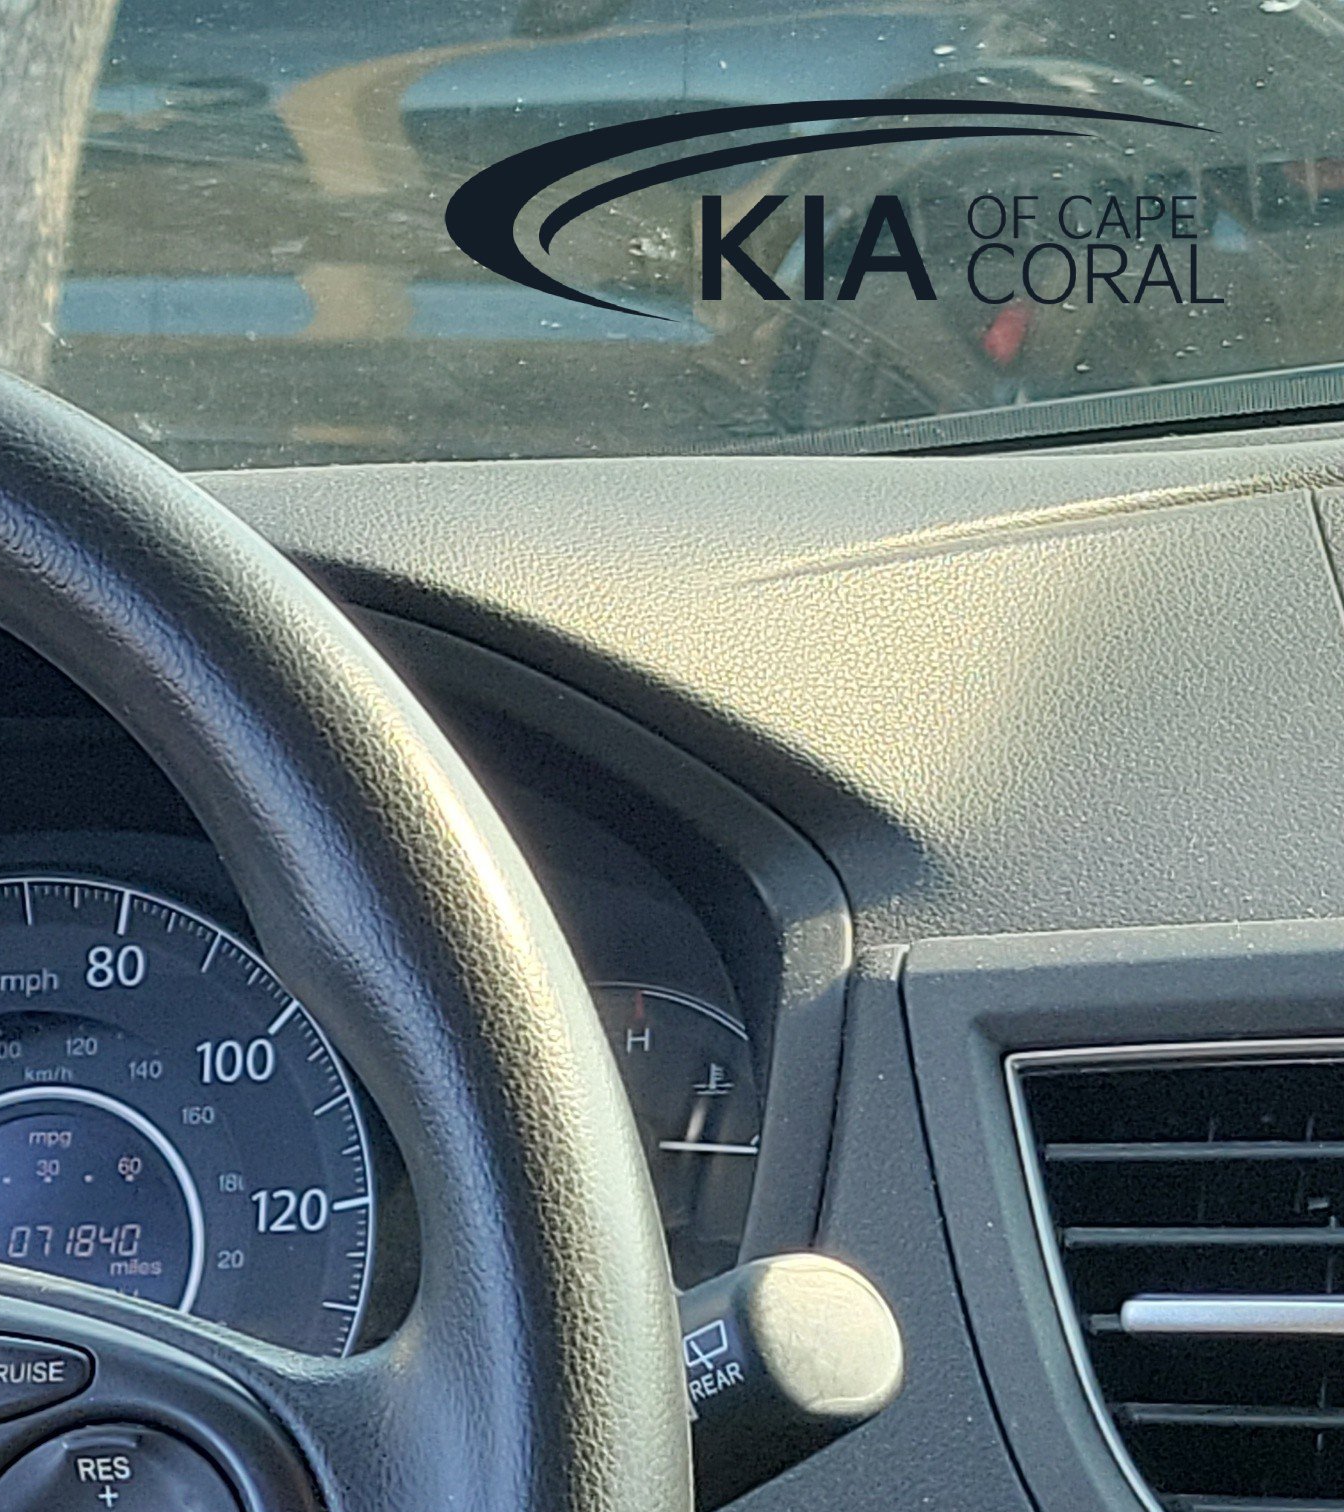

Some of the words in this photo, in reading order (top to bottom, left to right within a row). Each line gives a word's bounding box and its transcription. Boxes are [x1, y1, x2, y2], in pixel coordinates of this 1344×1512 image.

[87, 946, 144, 987] 80
[1, 968, 58, 996] mph
[67, 1038, 97, 1055] 120
[627, 1028, 649, 1053] H
[129, 1061, 162, 1078] 140
[197, 1039, 273, 1082] 100
[25, 1067, 72, 1081] km/h
[183, 1106, 214, 1124] 160
[29, 1132, 71, 1146] mpg
[36, 1160, 59, 1177] 30
[118, 1158, 141, 1174] 60
[252, 1189, 327, 1231] 120
[8, 1223, 141, 1258] 071840
[109, 1258, 162, 1276] miles
[689, 1361, 744, 1402] REAR
[78, 1457, 130, 1480] RES
